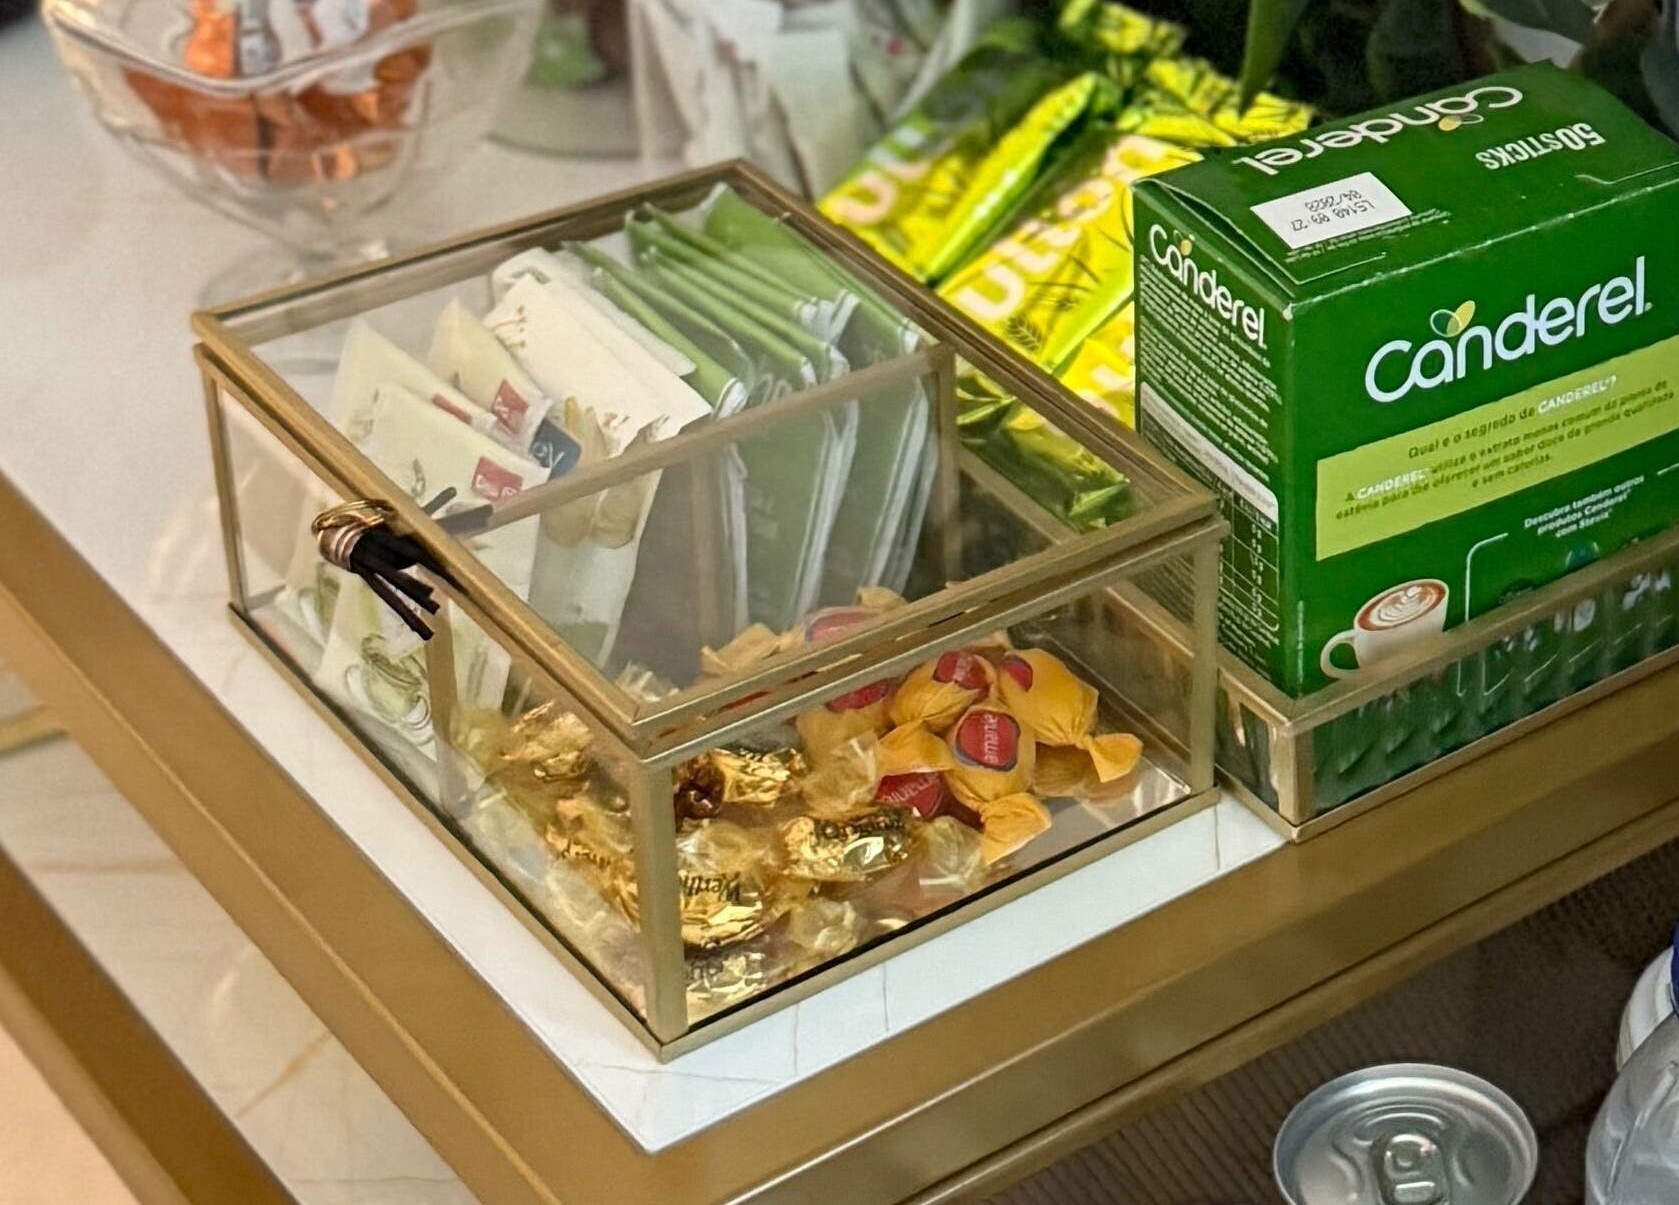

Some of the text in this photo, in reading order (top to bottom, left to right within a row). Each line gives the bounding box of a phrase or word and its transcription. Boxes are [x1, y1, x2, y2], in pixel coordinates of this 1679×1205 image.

[1232, 85, 1523, 176] Canderel
[1149, 224, 1265, 348] Canderel
[1365, 256, 1646, 403] Canderel
[1408, 438, 1439, 459] Qual
[1519, 406, 1536, 420] de
